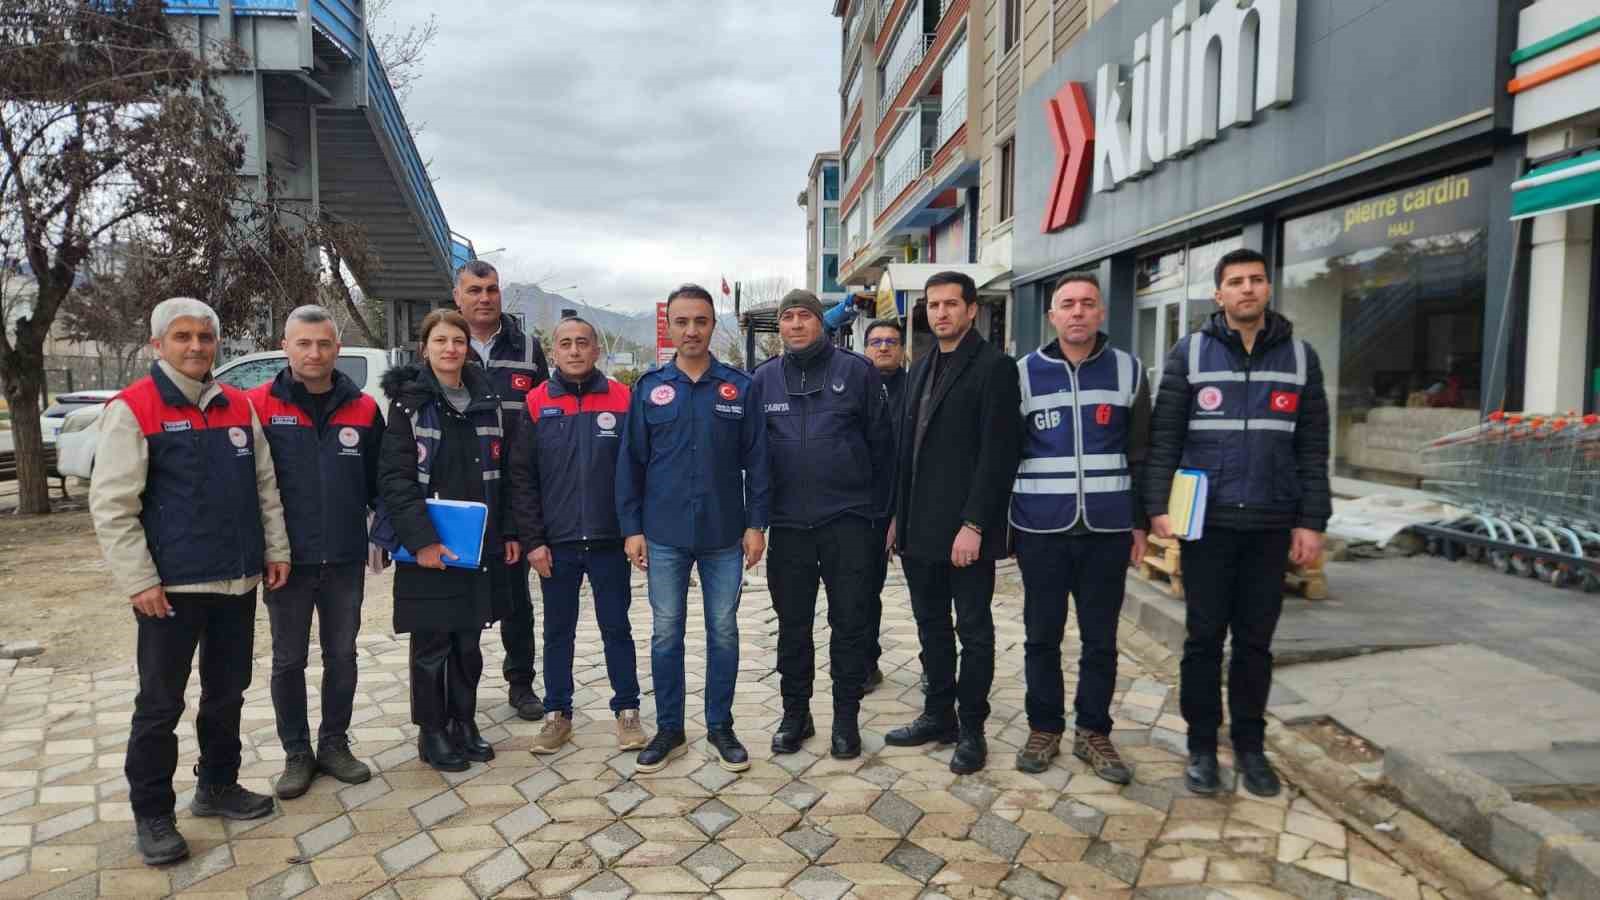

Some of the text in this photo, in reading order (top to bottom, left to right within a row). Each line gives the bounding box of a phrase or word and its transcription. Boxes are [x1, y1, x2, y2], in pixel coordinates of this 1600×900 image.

[1093, 0, 1297, 193] kilim
[1343, 176, 1470, 232] pierre cardin
